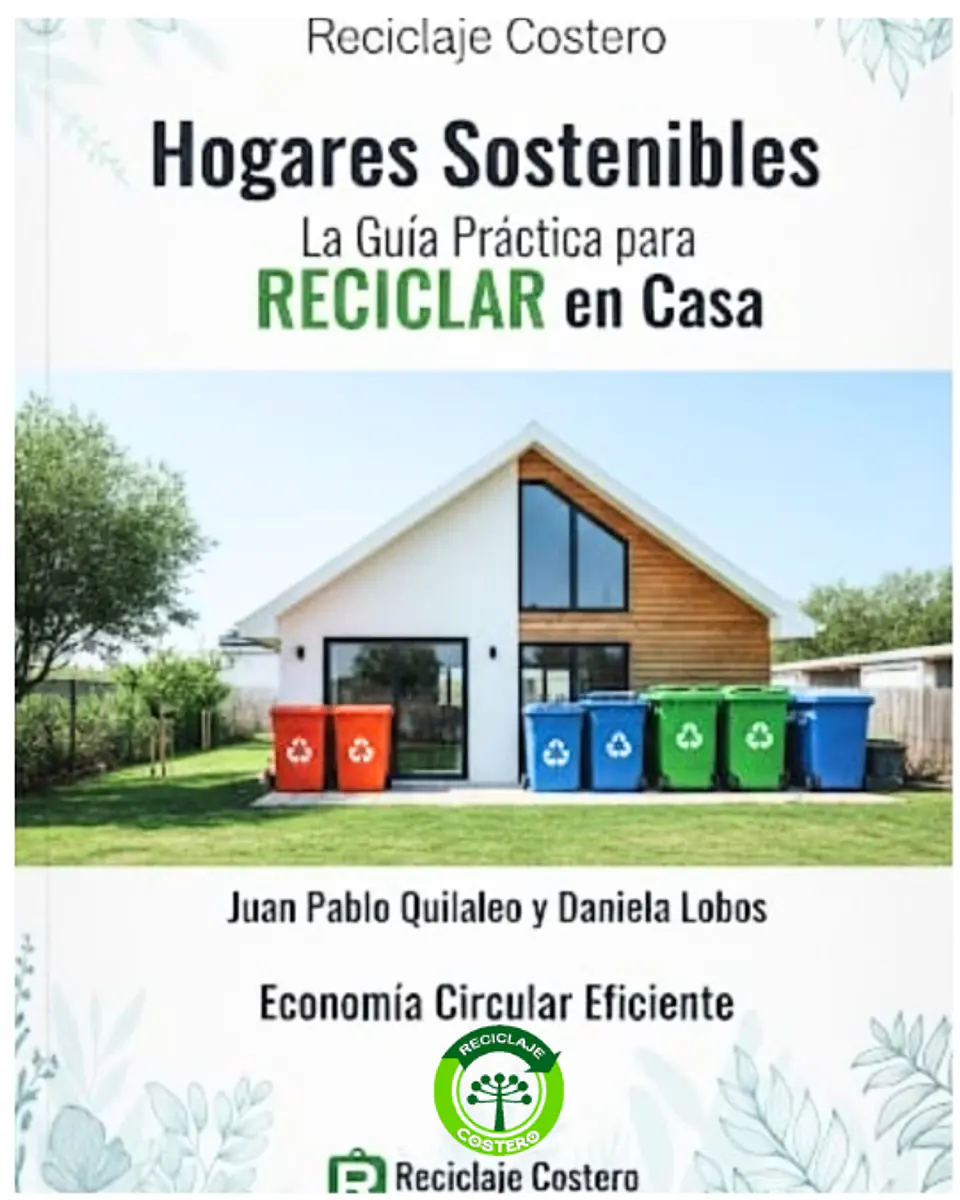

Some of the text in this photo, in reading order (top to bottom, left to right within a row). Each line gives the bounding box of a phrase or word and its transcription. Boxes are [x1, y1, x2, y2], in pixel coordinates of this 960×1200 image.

[308, 18, 666, 64] Reciclaje Costero
[152, 118, 821, 202] Hogares Sostenibles
[302, 213, 696, 267] La Guía Práctica para
[257, 267, 764, 331] RECICLAR en Casa
[227, 889, 768, 930] Juan Pablo Quilaleo y Daniela Lobos
[260, 982, 734, 1022] Economía Circular Eficiente
[458, 1032, 546, 1061] RECICLAJE
[456, 1127, 541, 1154] COSTERO
[395, 1159, 640, 1192] Reciclaje Costero
